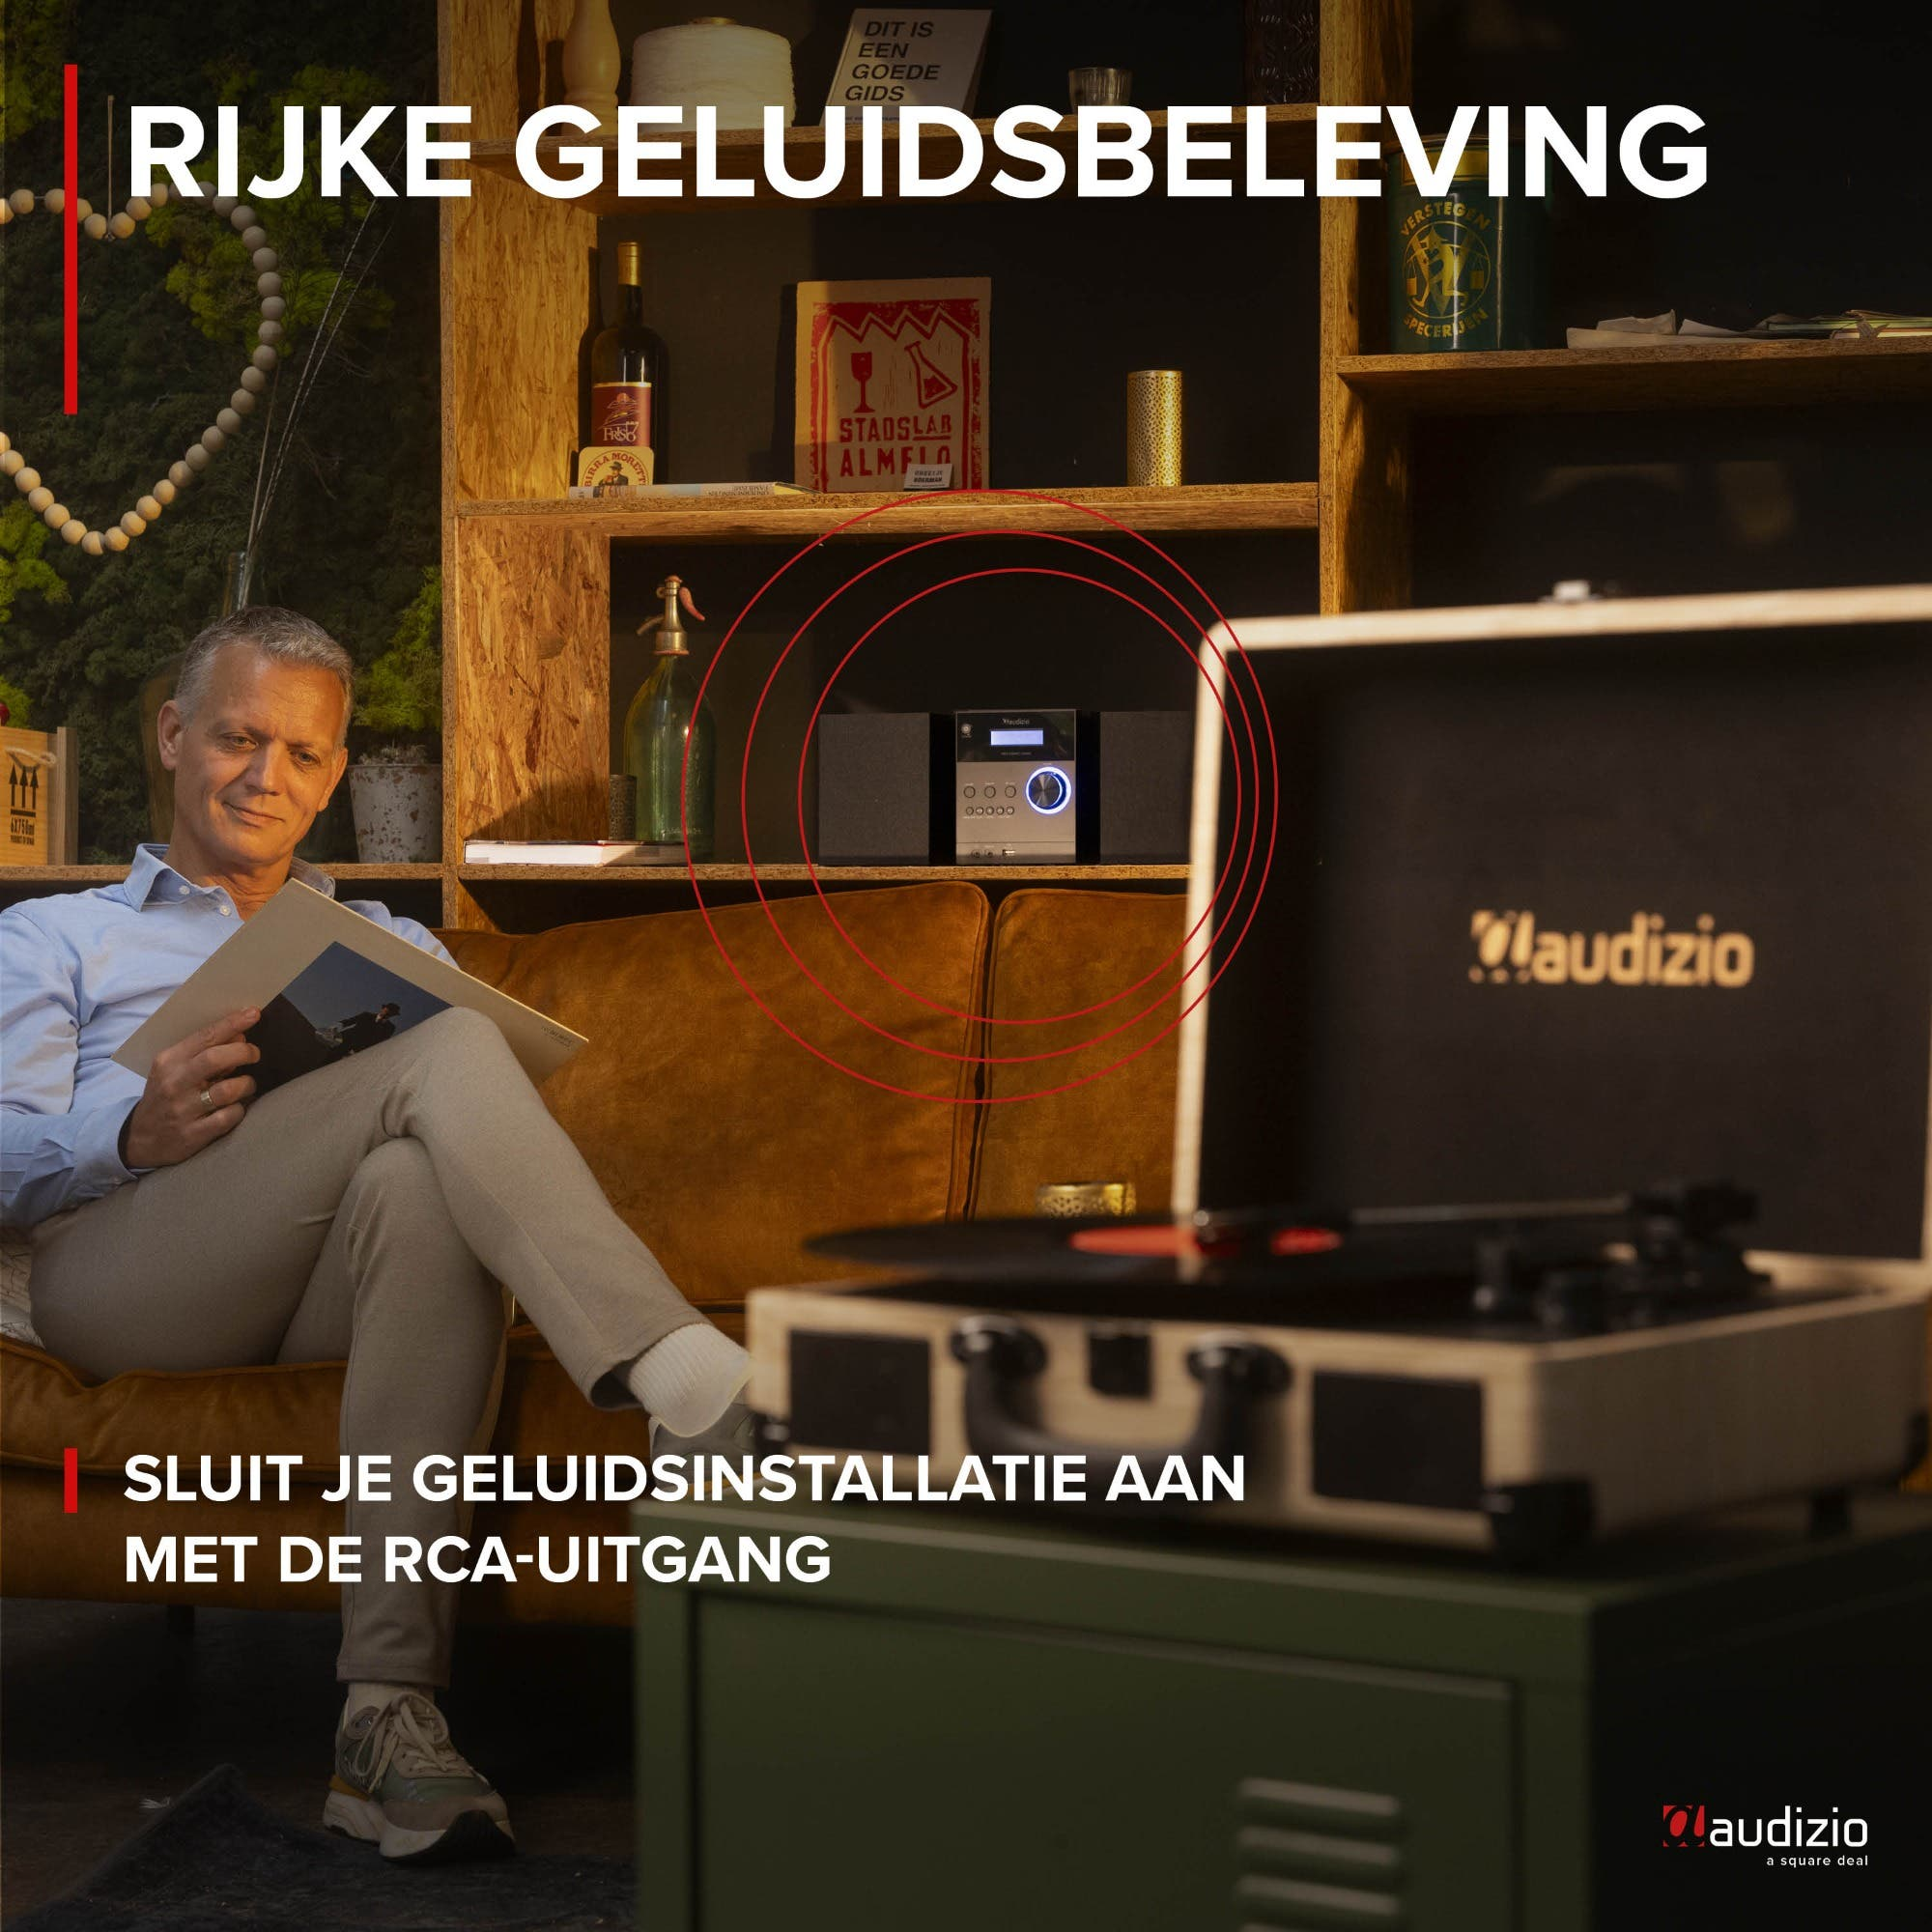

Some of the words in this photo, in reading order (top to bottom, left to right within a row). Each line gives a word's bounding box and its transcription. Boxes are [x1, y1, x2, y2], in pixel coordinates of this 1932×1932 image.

[865, 21, 905, 37] DIT
[911, 21, 934, 38] IS
[858, 43, 909, 58] EEN
[851, 64, 941, 80] GOEDE
[845, 85, 905, 101] GIDS
[1401, 201, 1492, 237] VERSTEGEN
[839, 414, 952, 443] STADSLAB
[611, 452, 648, 486] MORETT
[1532, 911, 1755, 988] audizio
